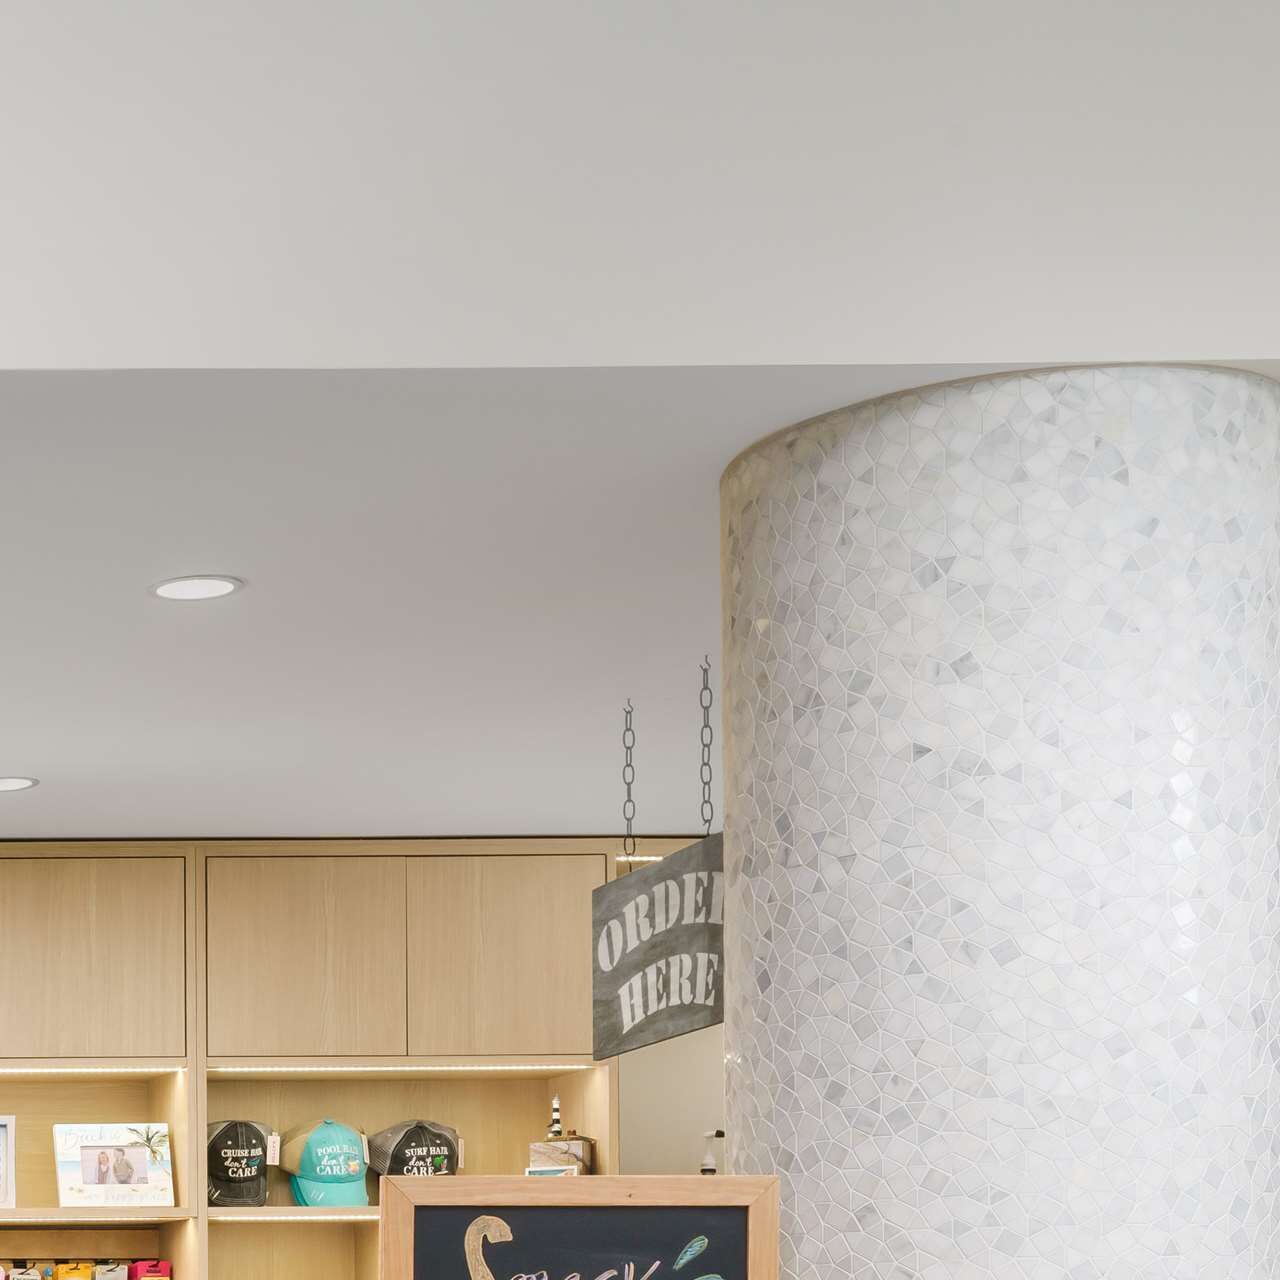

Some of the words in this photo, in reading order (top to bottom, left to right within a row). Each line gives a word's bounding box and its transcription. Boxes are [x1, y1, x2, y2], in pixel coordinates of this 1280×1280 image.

[617, 951, 719, 1035] HERE
[221, 1148, 249, 1157] CRUISE
[316, 1145, 341, 1156] POOL
[405, 1148, 429, 1157] SURF
[430, 1146, 448, 1156] HAIR
[228, 1167, 258, 1178] CARE
[316, 1165, 347, 1176] CARE
[403, 1166, 435, 1176] CARE
